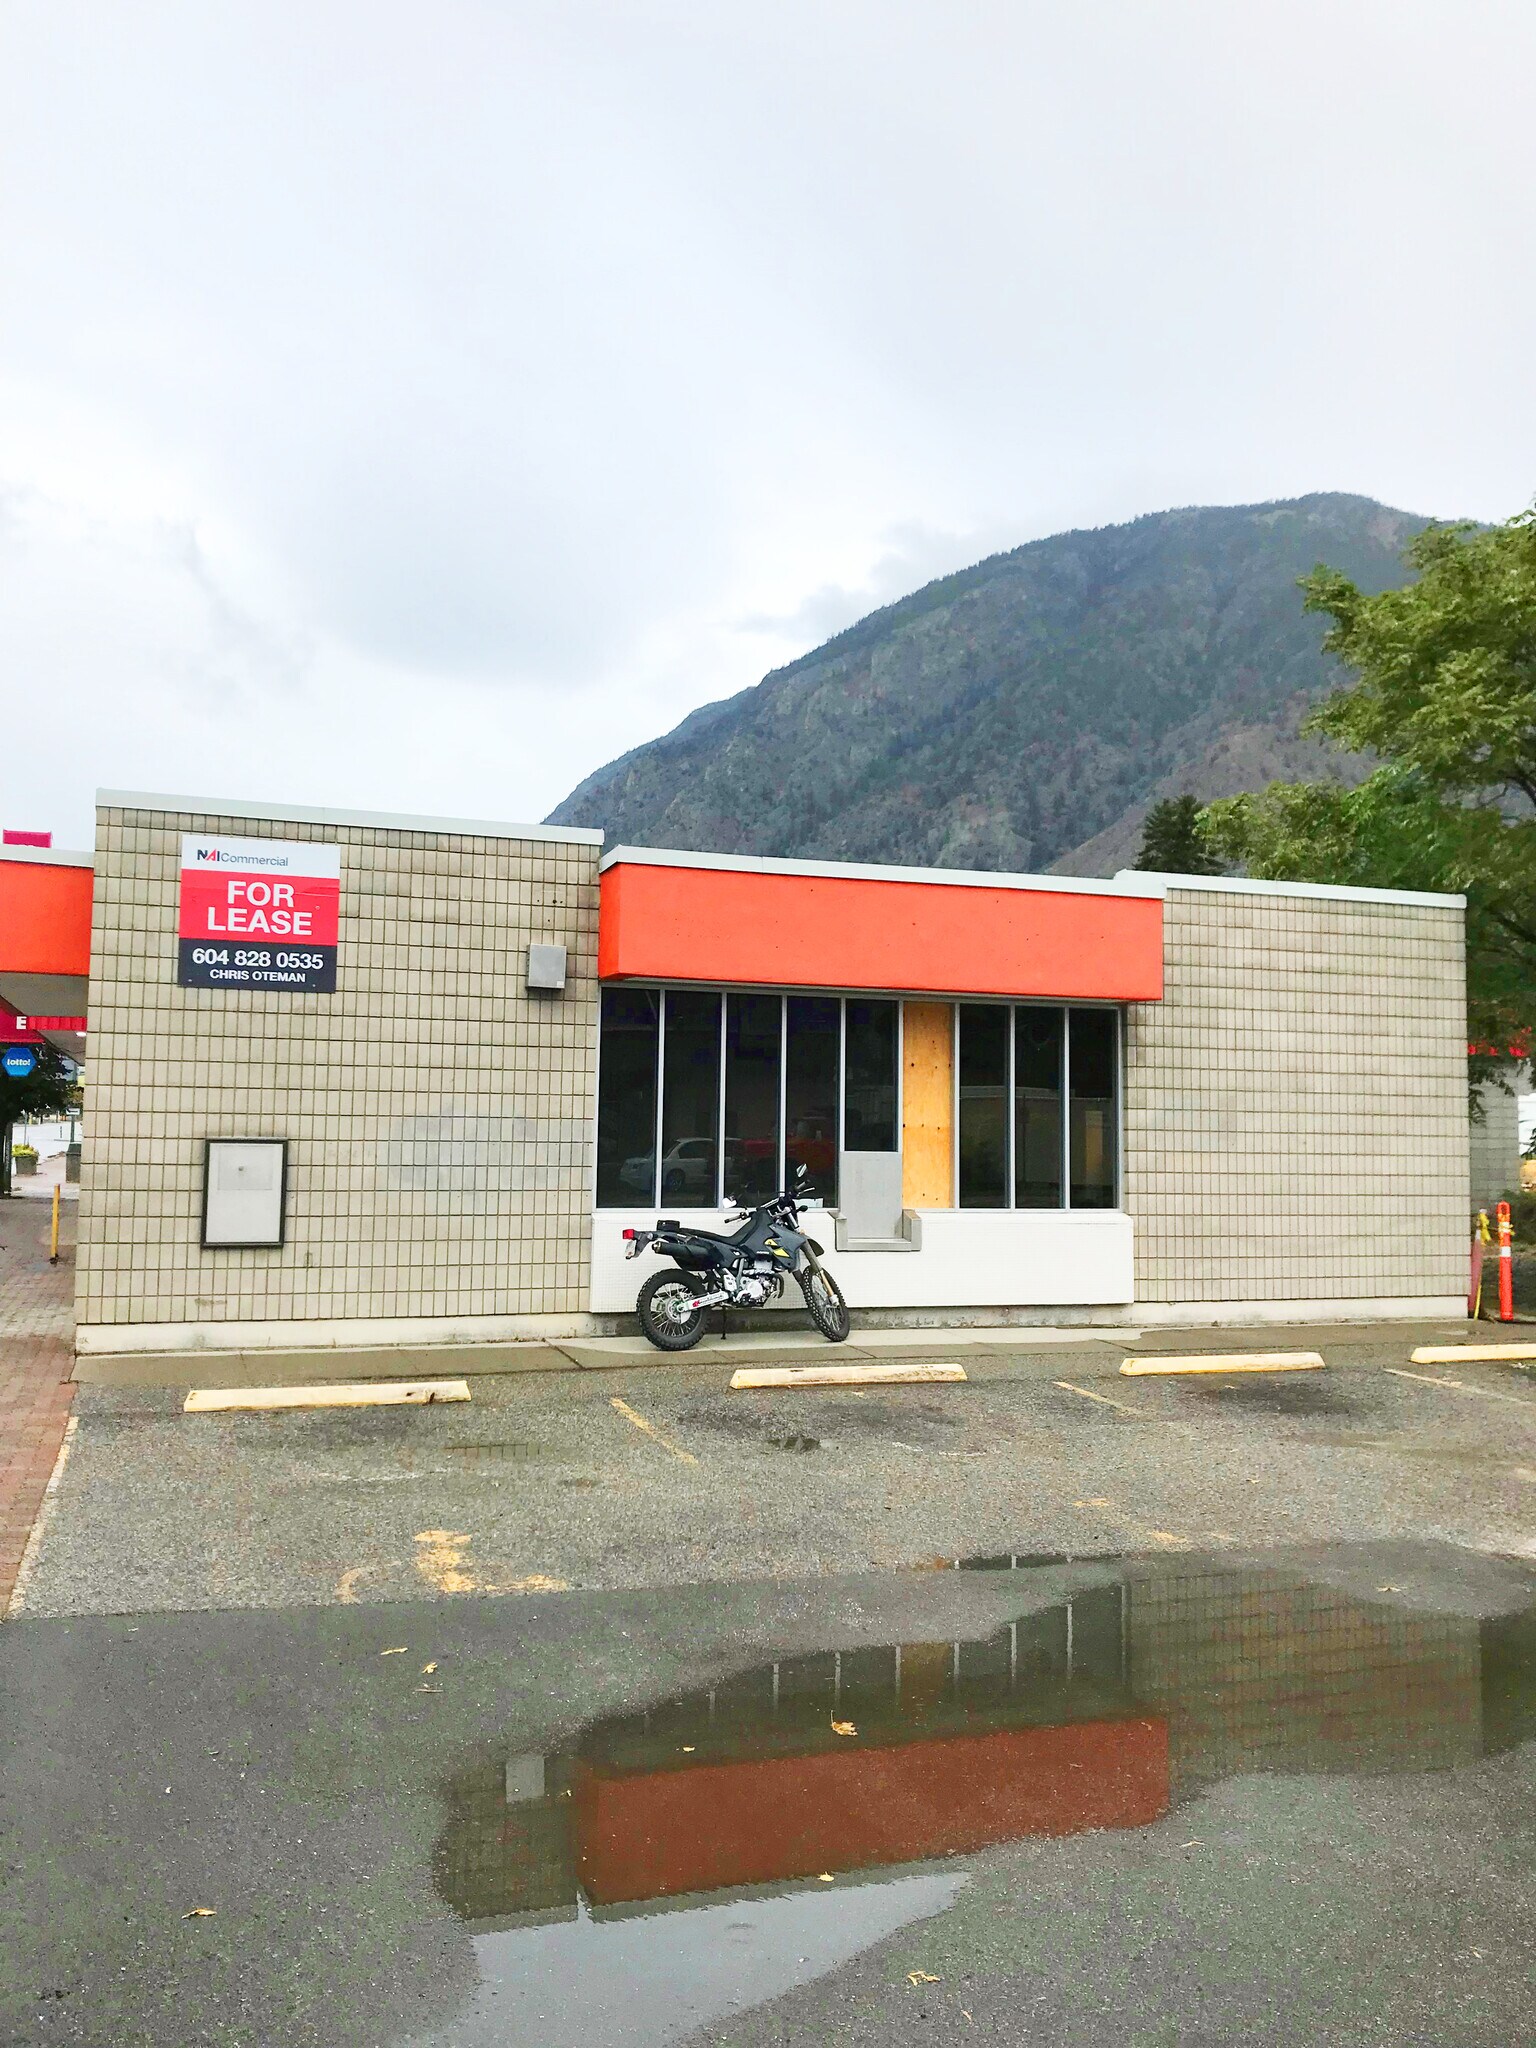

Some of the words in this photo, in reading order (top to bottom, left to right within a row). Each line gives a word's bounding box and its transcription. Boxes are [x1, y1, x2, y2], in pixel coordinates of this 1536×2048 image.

[227, 880, 295, 908] FOR
[207, 906, 313, 936] LEASE
[192, 948, 230, 965] 604
[234, 949, 271, 967] 828
[276, 952, 324, 970] 0535
[209, 968, 250, 981] CHRIS
[252, 970, 306, 983] OTEMAN
[16, 1016, 27, 1030] E
